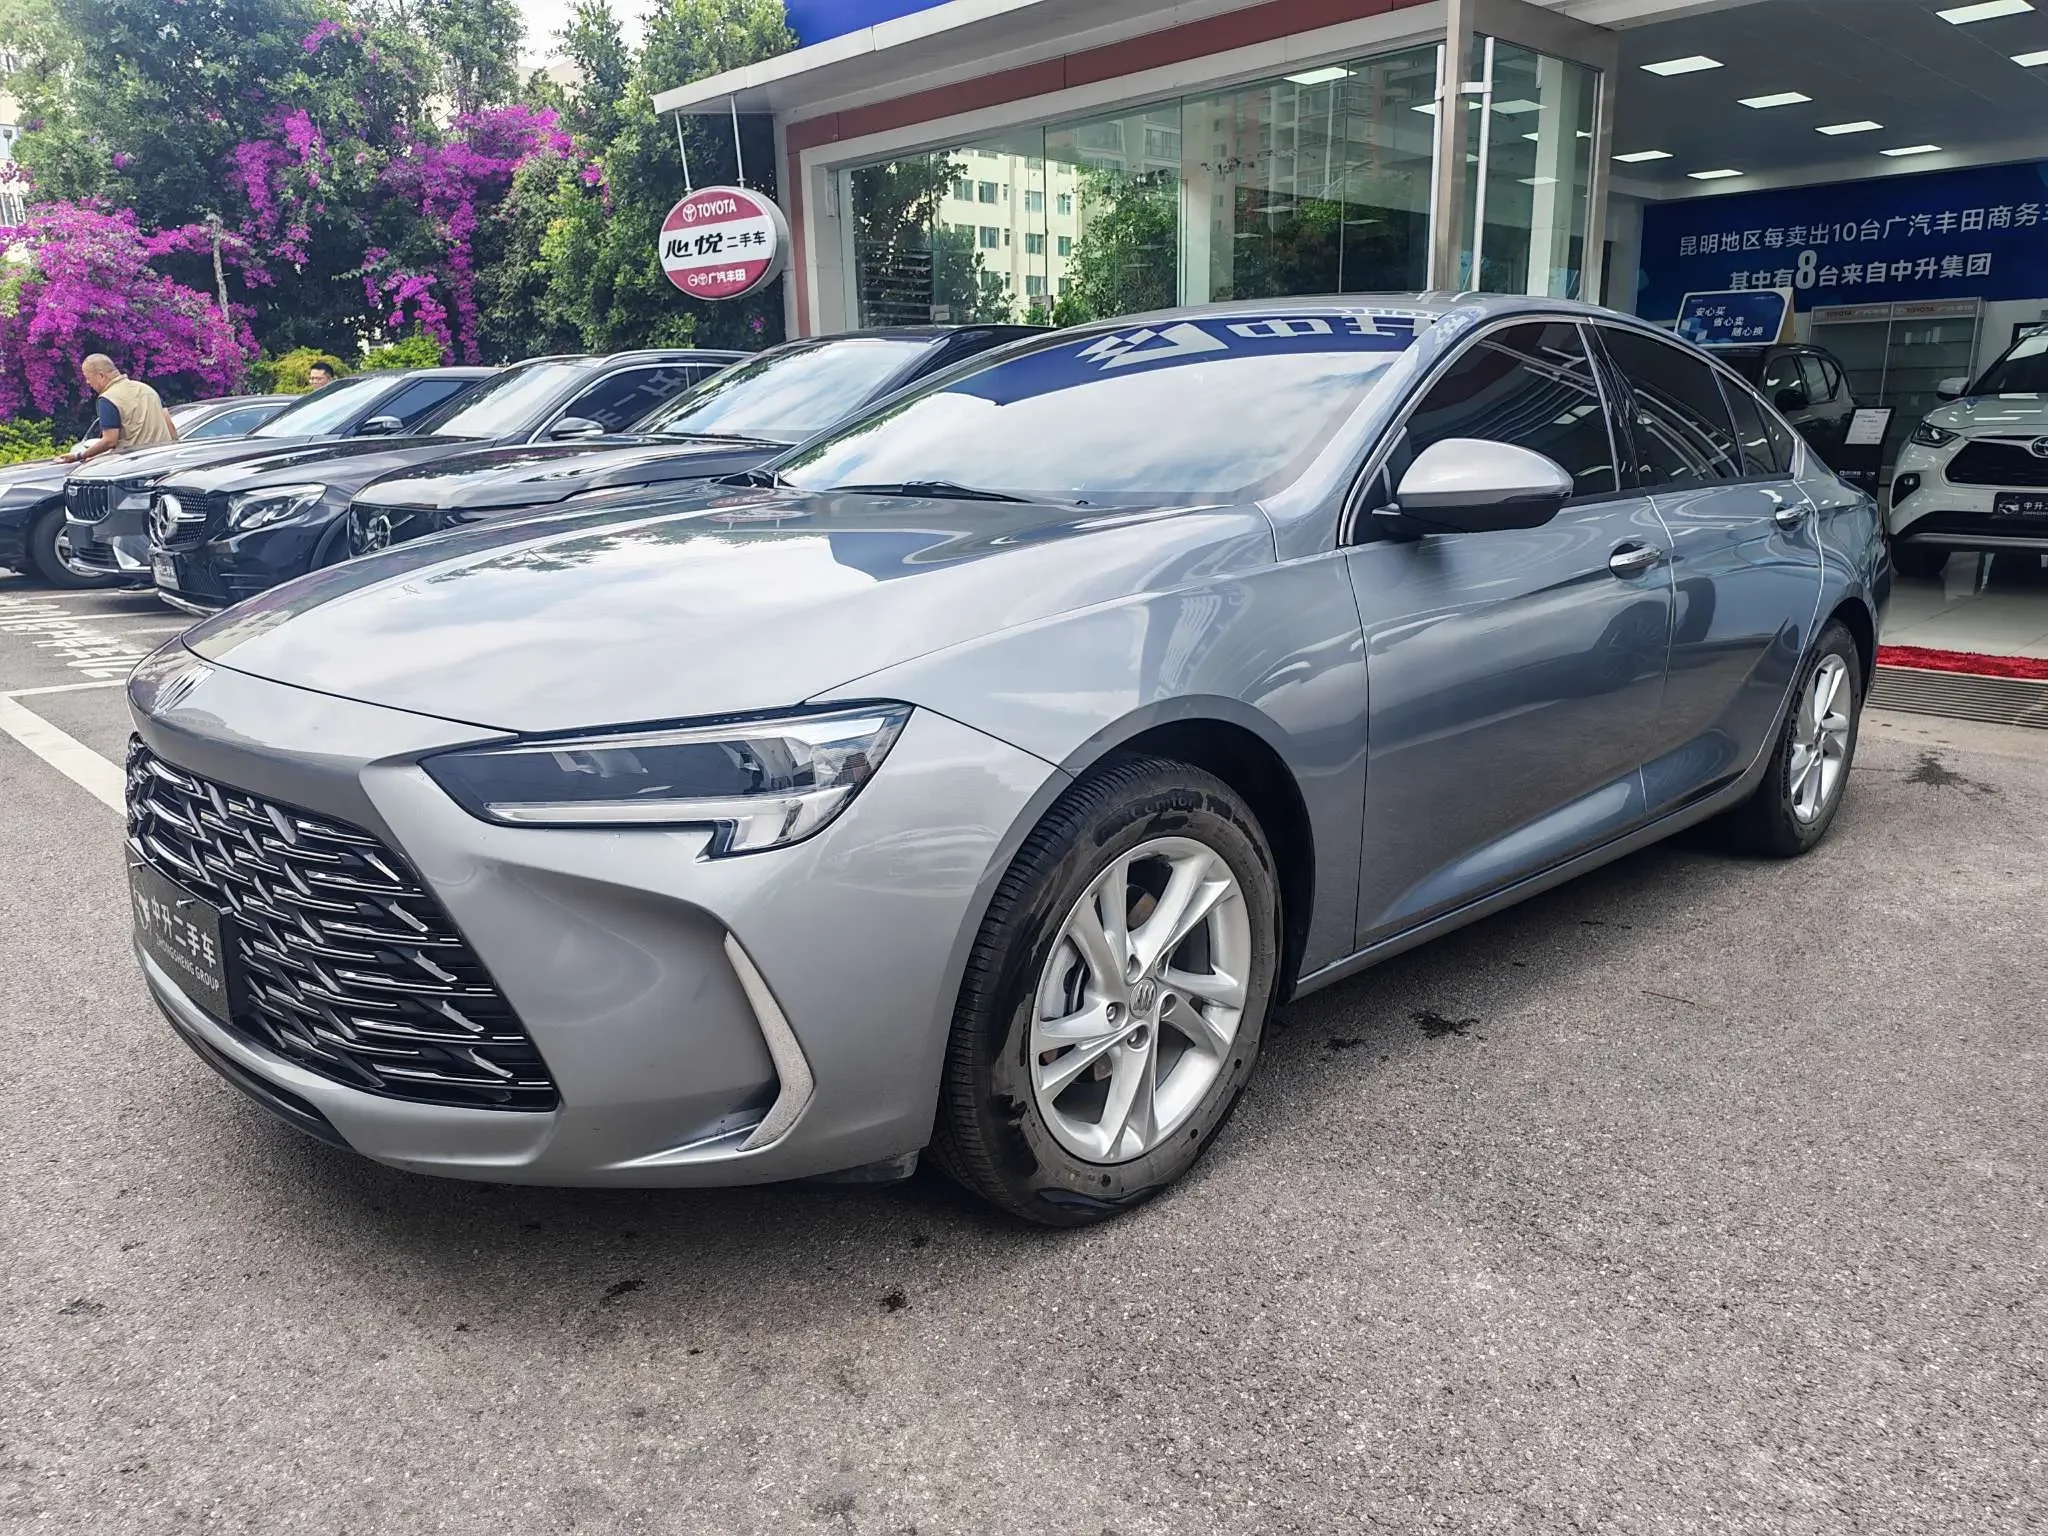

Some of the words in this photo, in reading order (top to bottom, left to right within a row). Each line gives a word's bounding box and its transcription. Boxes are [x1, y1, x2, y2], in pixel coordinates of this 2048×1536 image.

[698, 199, 737, 218] TOYOTA
[709, 270, 746, 285] 广汽丰田
[1695, 306, 1726, 317] 安心买
[1713, 316, 1745, 327] 省心卖
[151, 896, 217, 968] 中升二手车
[195, 966, 219, 992] GROUP
